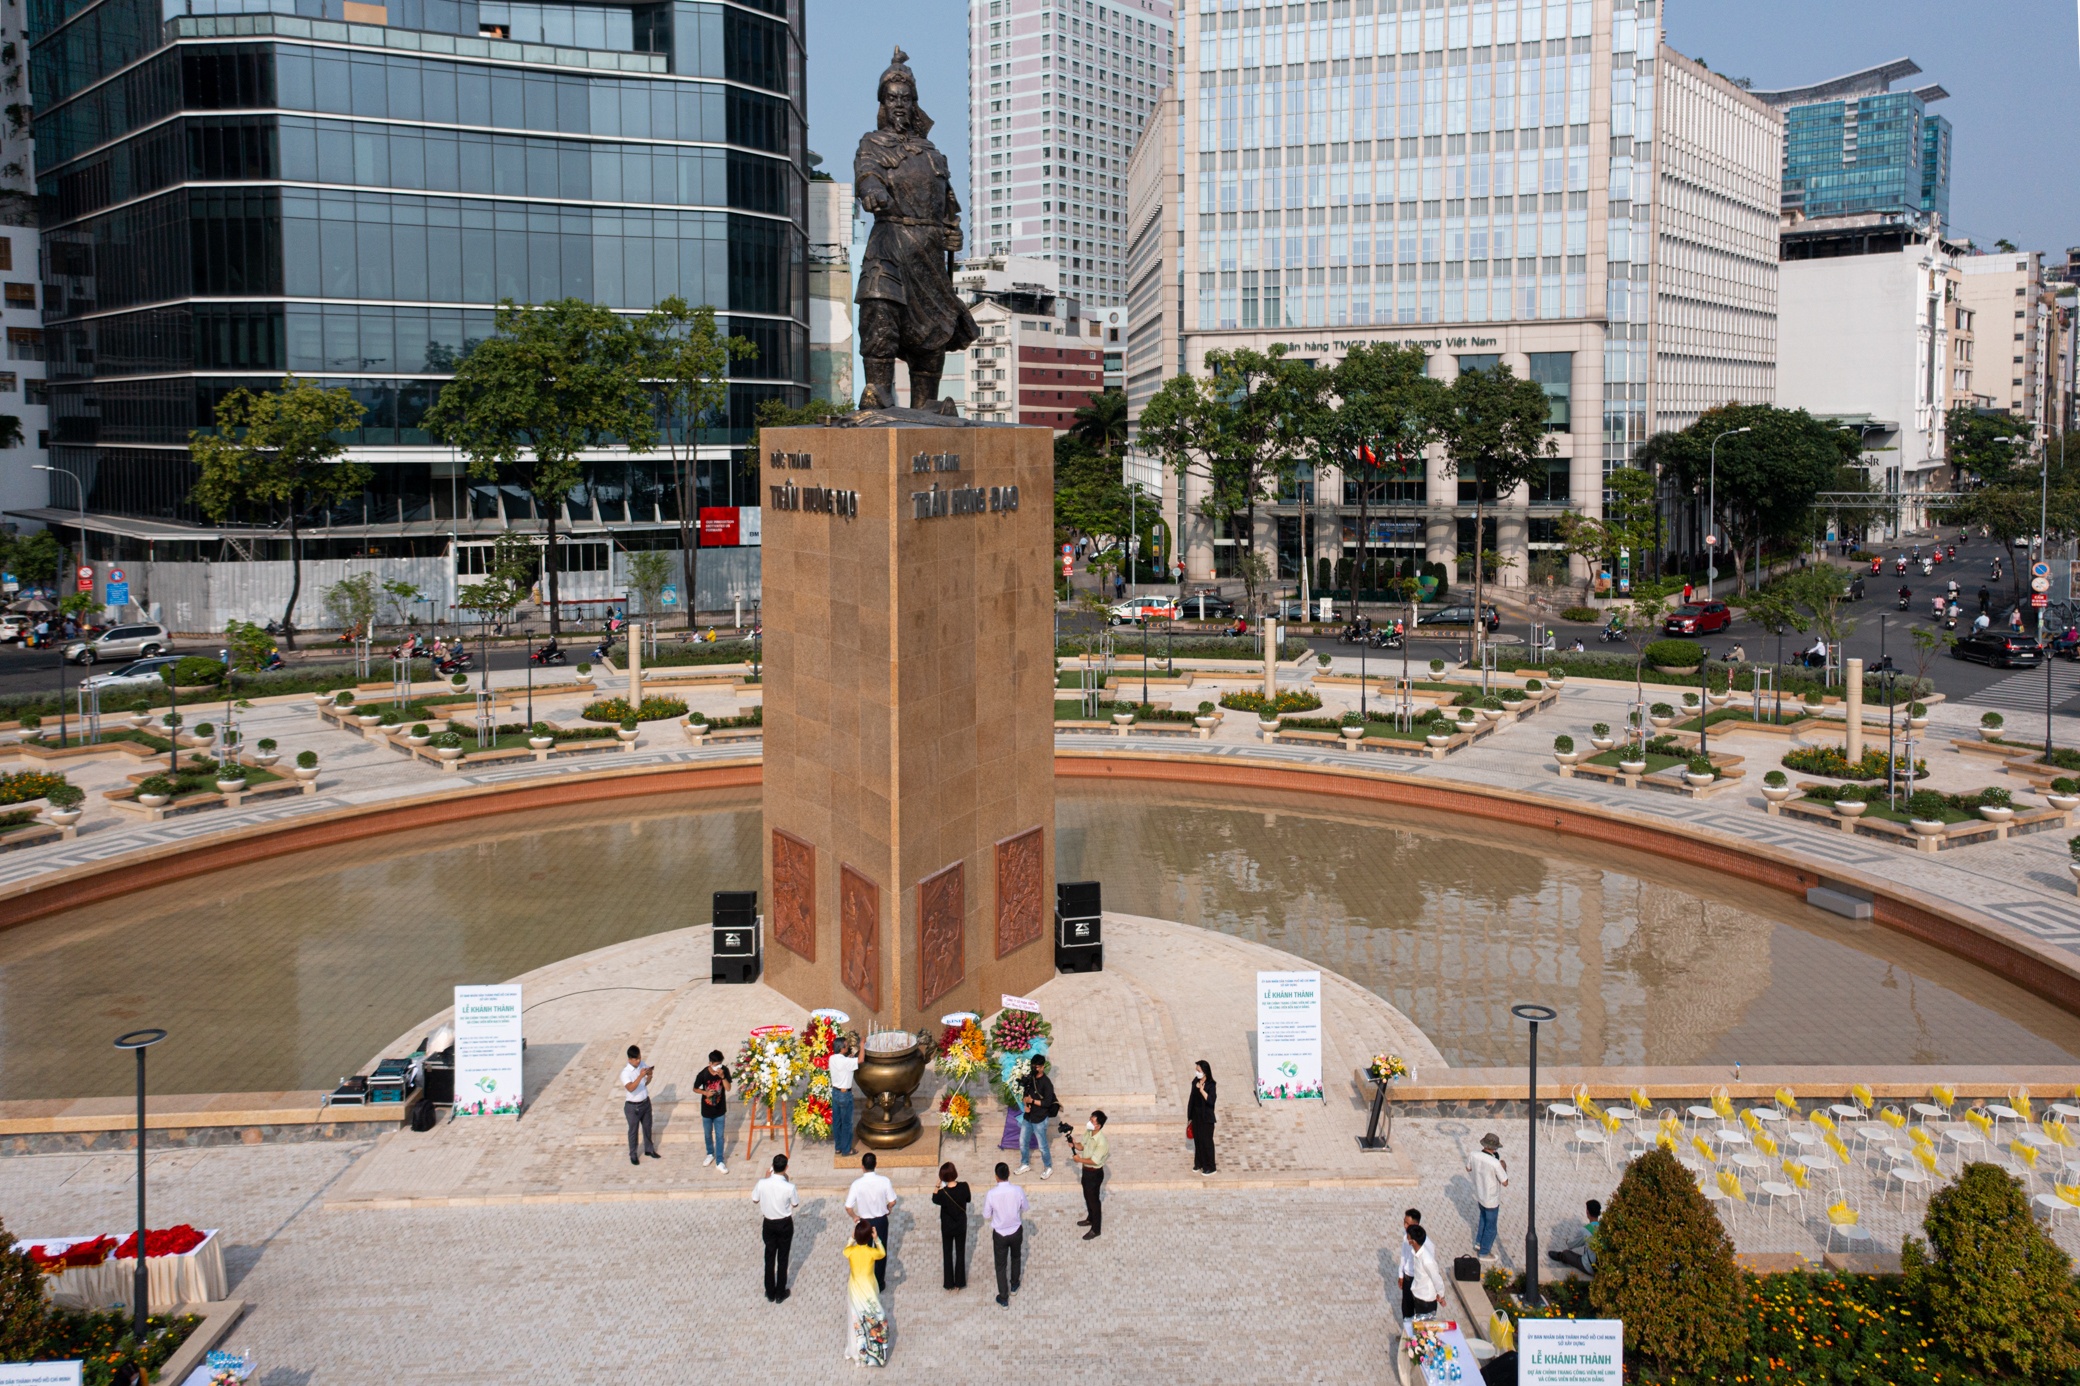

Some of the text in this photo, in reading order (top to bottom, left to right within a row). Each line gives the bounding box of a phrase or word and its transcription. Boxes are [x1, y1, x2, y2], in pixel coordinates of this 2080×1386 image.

[1305, 341, 1329, 352] hàng
[1446, 337, 1466, 348] Việt
[1471, 337, 1496, 347] Nam
[770, 478, 858, 524] TRẦN HƯNG ĐẠO
[912, 482, 1018, 520] TRẦN HƯNG ĐẠO
[1264, 989, 1270, 998] LỄ
[462, 1004, 469, 1013] LỄ
[471, 1005, 492, 1013] KHÁNH
[1532, 1350, 1611, 1364] LỄ KHÁNH THÀNH
